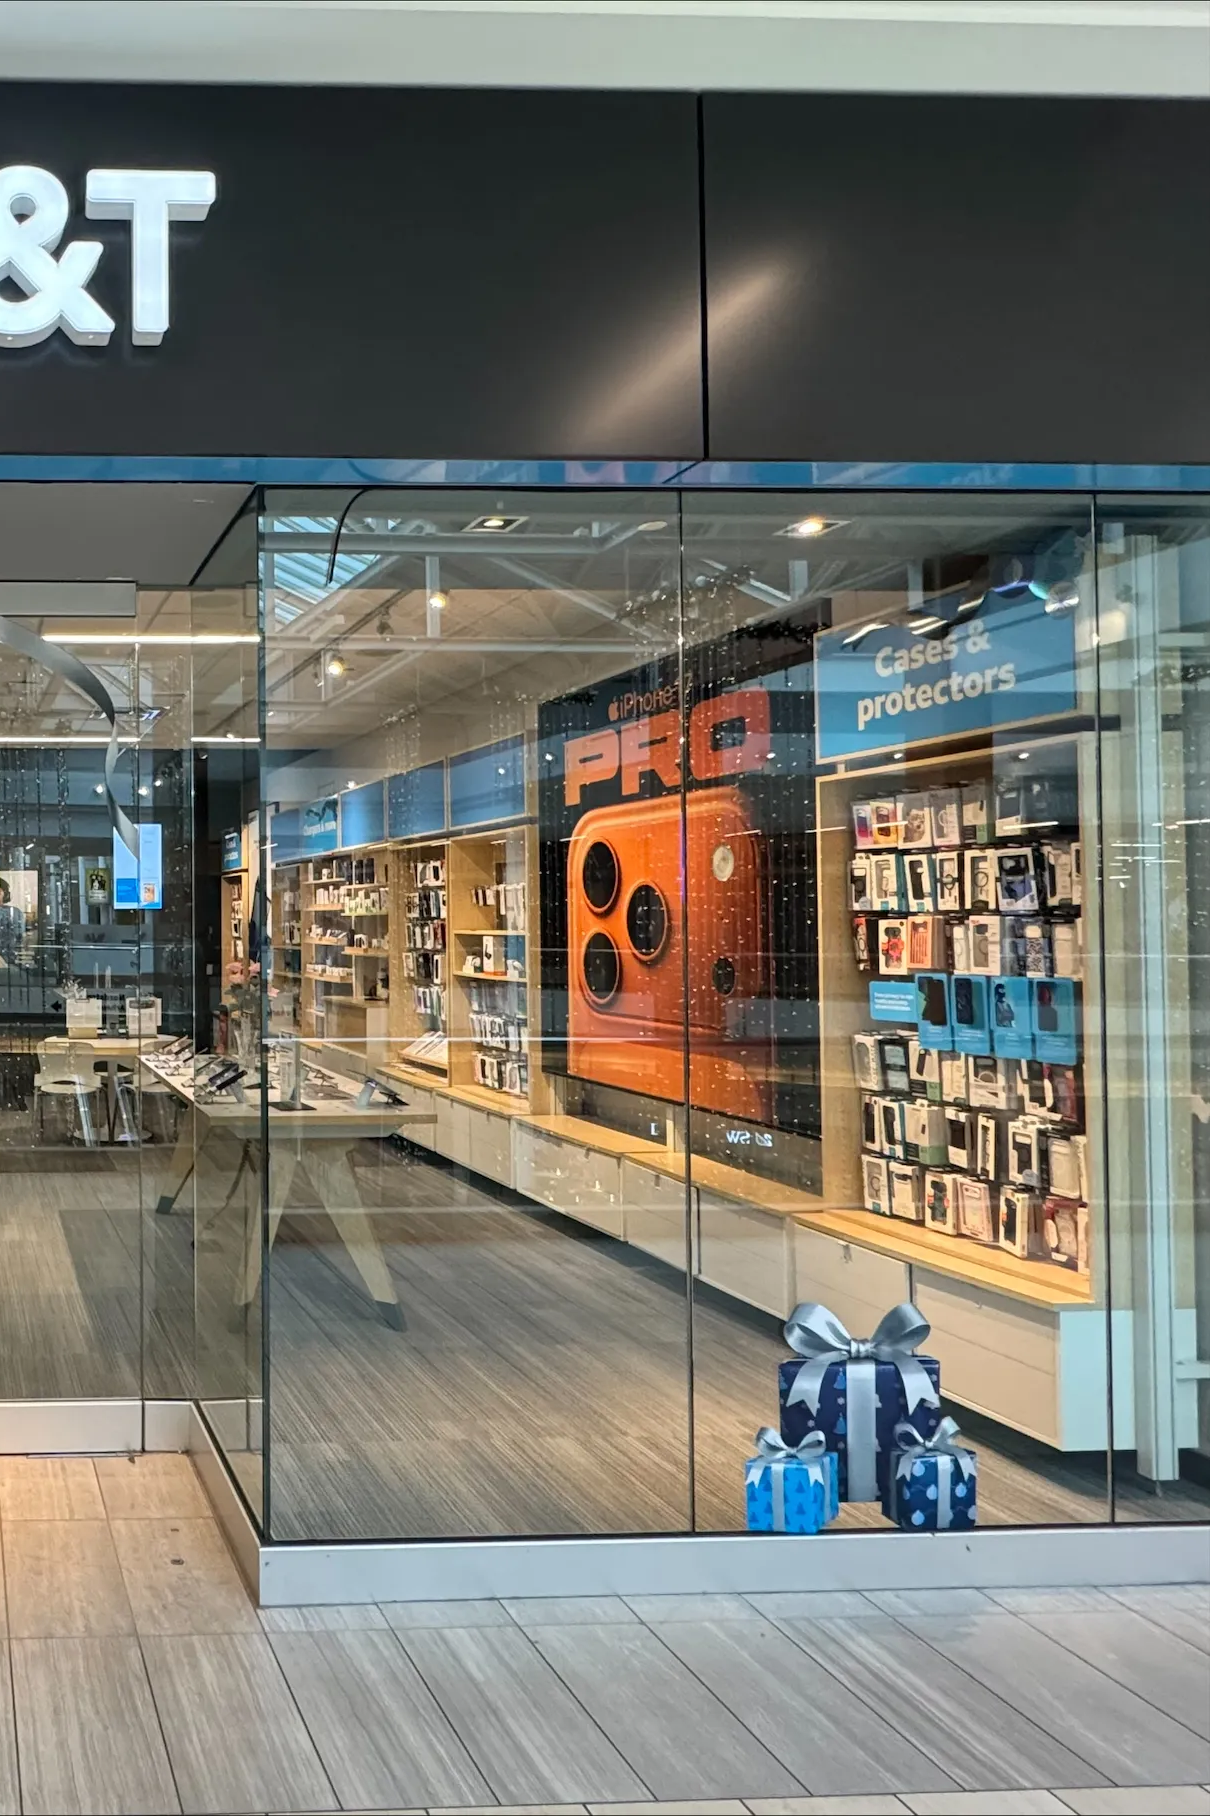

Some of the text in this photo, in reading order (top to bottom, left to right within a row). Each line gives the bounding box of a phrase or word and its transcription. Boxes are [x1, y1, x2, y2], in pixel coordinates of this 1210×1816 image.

[874, 618, 992, 678] Cases &
[857, 662, 1017, 731] protectors
[563, 686, 770, 807] PRO
